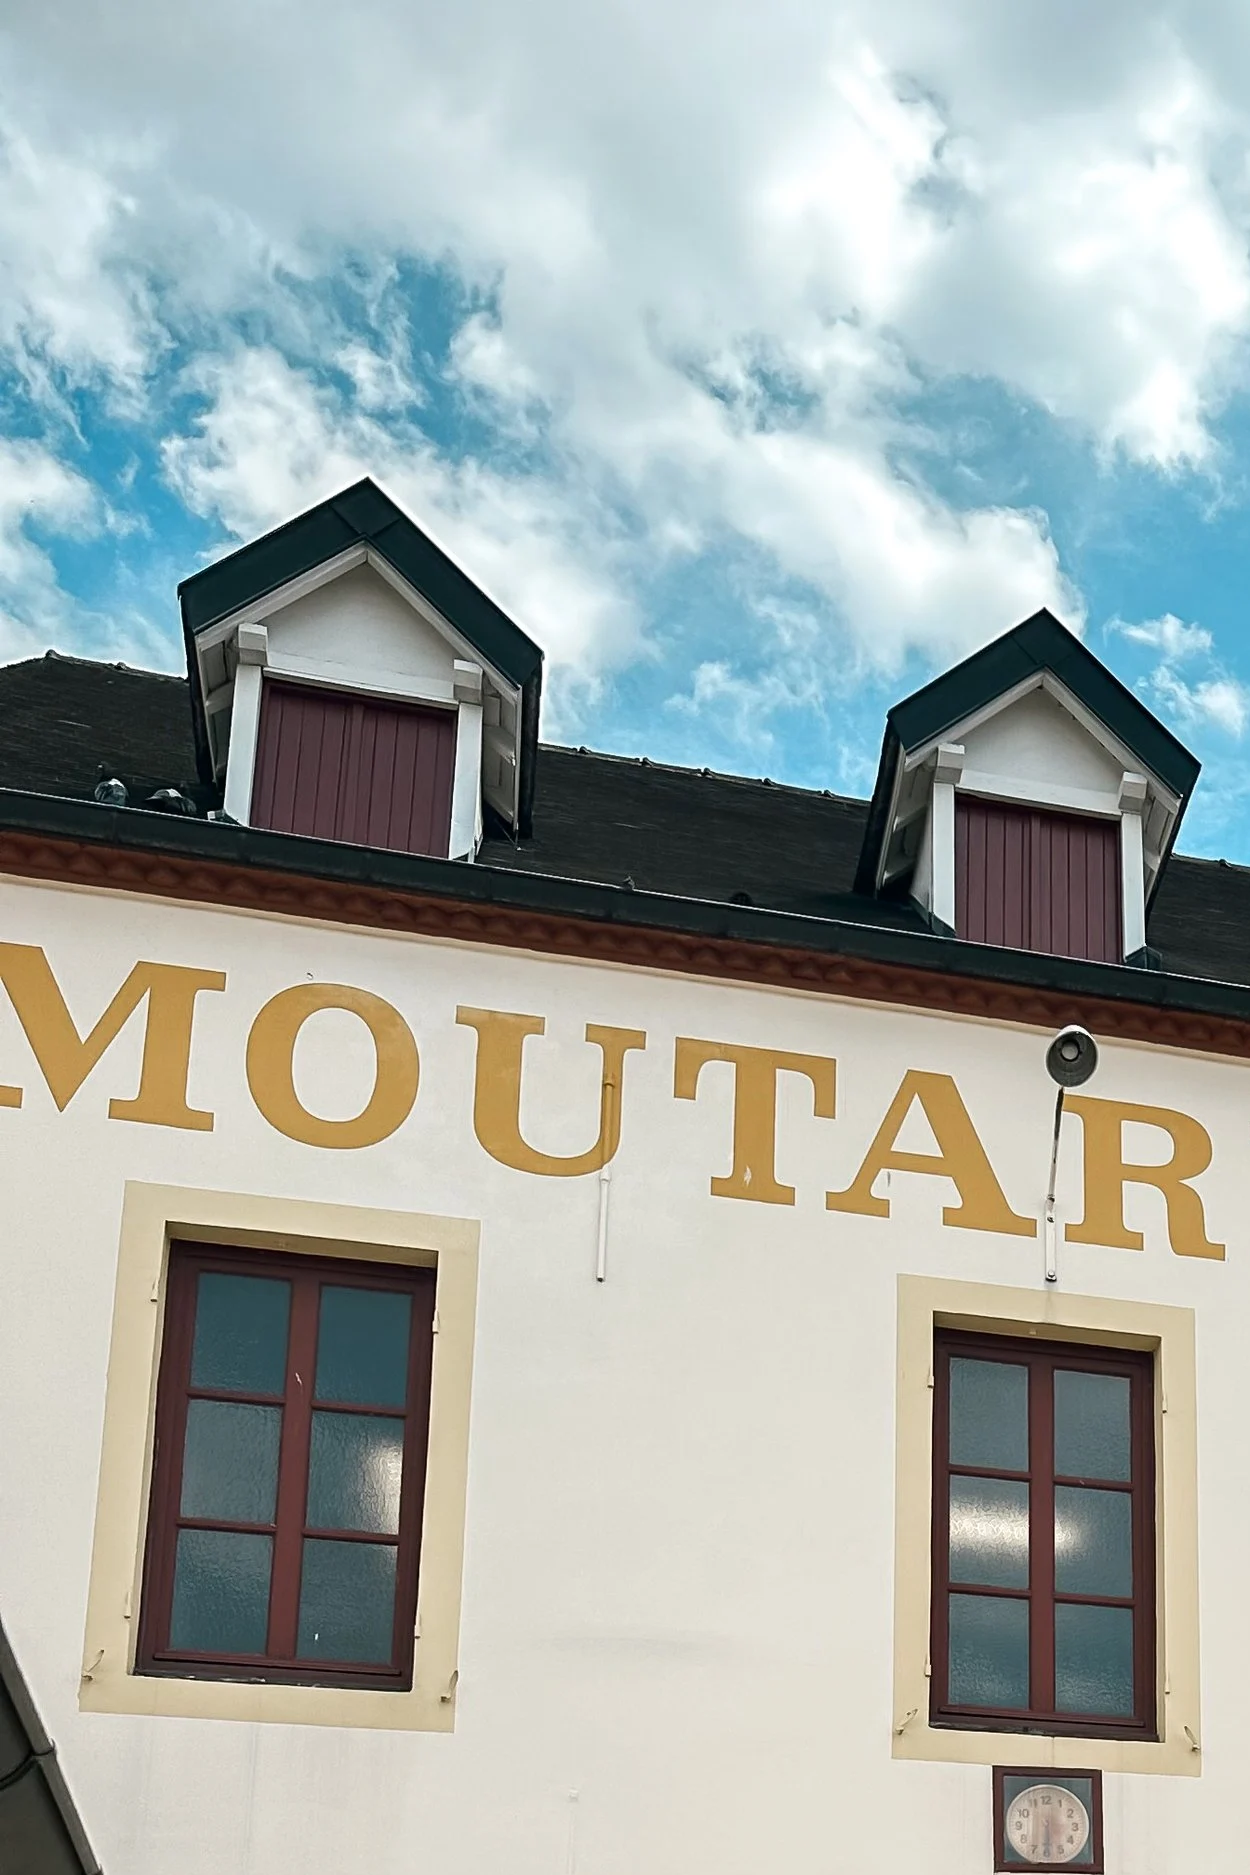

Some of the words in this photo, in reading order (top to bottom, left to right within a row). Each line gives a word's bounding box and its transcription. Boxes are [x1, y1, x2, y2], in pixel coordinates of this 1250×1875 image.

[1030, 1798, 1038, 1808] 11
[1040, 1795, 1052, 1806] 12
[1058, 1799, 1063, 1808] 1
[1017, 1808, 1029, 1818] 10
[1067, 1808, 1074, 1819] 2
[1015, 1821, 1023, 1831] 9
[1072, 1822, 1079, 1832] 3
[1020, 1834, 1028, 1844] 8
[1067, 1835, 1074, 1845] 4
[1031, 1845, 1038, 1854] 7
[1058, 1845, 1065, 1855] 5
